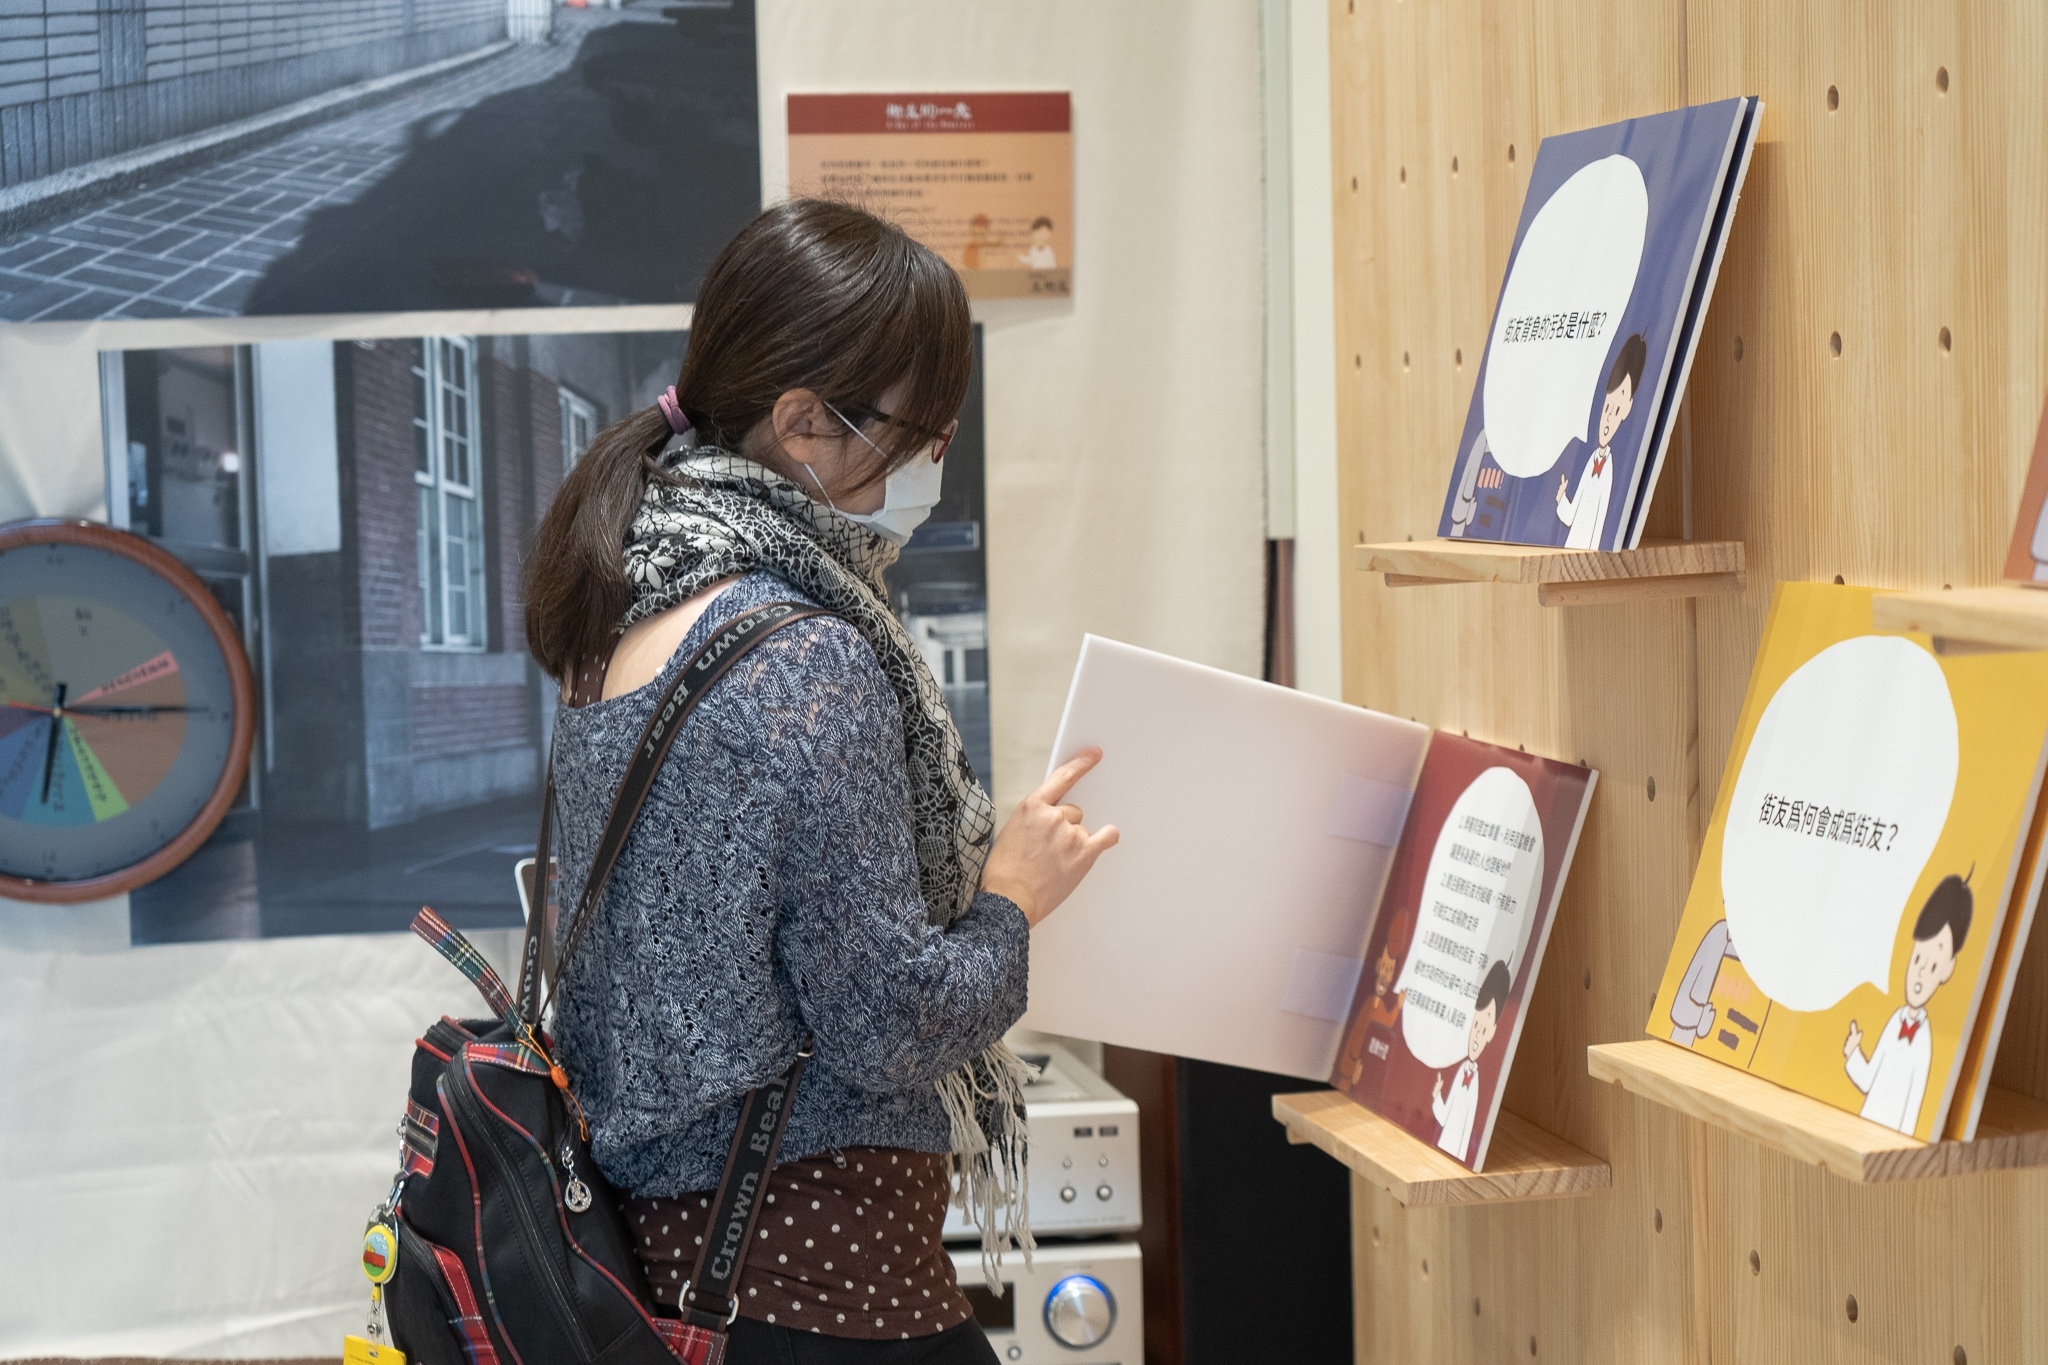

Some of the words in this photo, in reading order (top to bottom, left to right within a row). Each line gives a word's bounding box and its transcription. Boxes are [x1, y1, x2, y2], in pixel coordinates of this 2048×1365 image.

[695, 604, 794, 671] Crown
[643, 679, 691, 759] Bear
[711, 1172, 759, 1280] Crown
